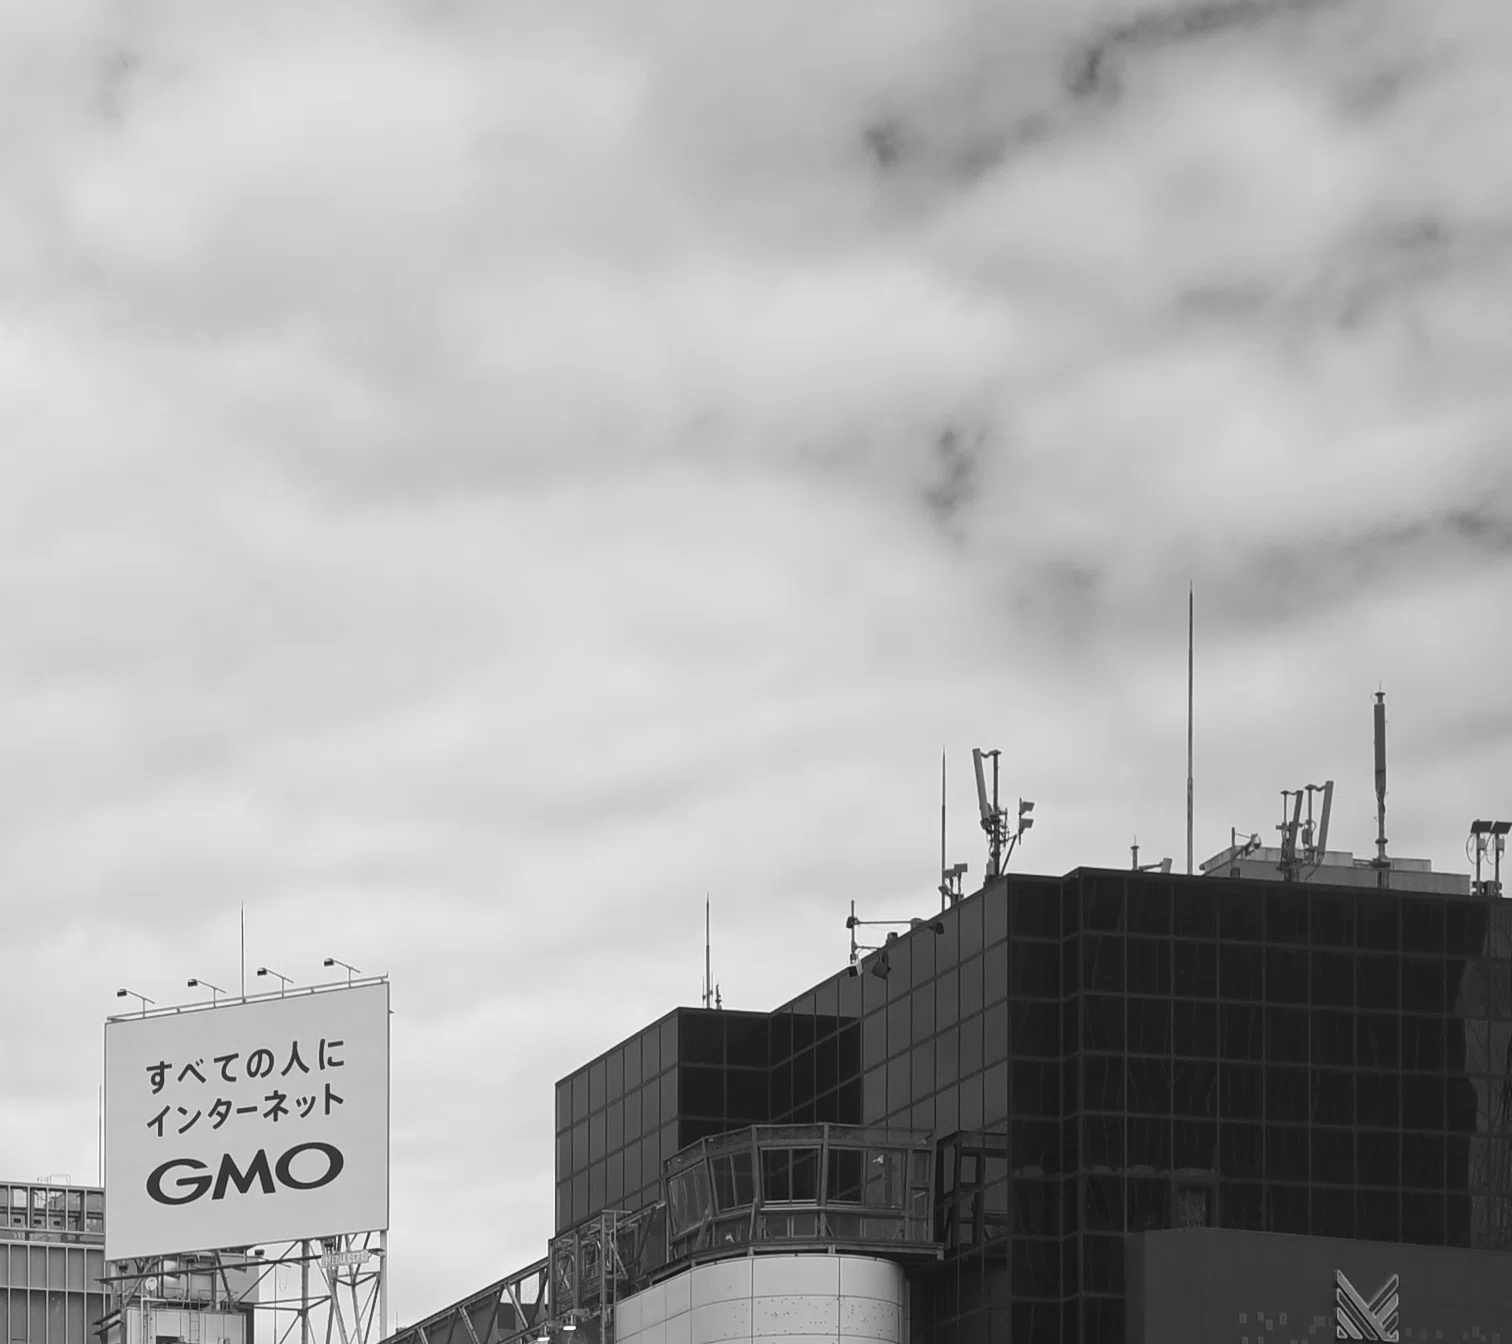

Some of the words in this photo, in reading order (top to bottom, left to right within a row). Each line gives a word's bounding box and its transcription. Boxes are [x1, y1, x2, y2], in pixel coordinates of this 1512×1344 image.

[146, 1038, 344, 1094] すべての人に
[146, 1083, 344, 1136] インターネット
[146, 1142, 344, 1205] GMO
